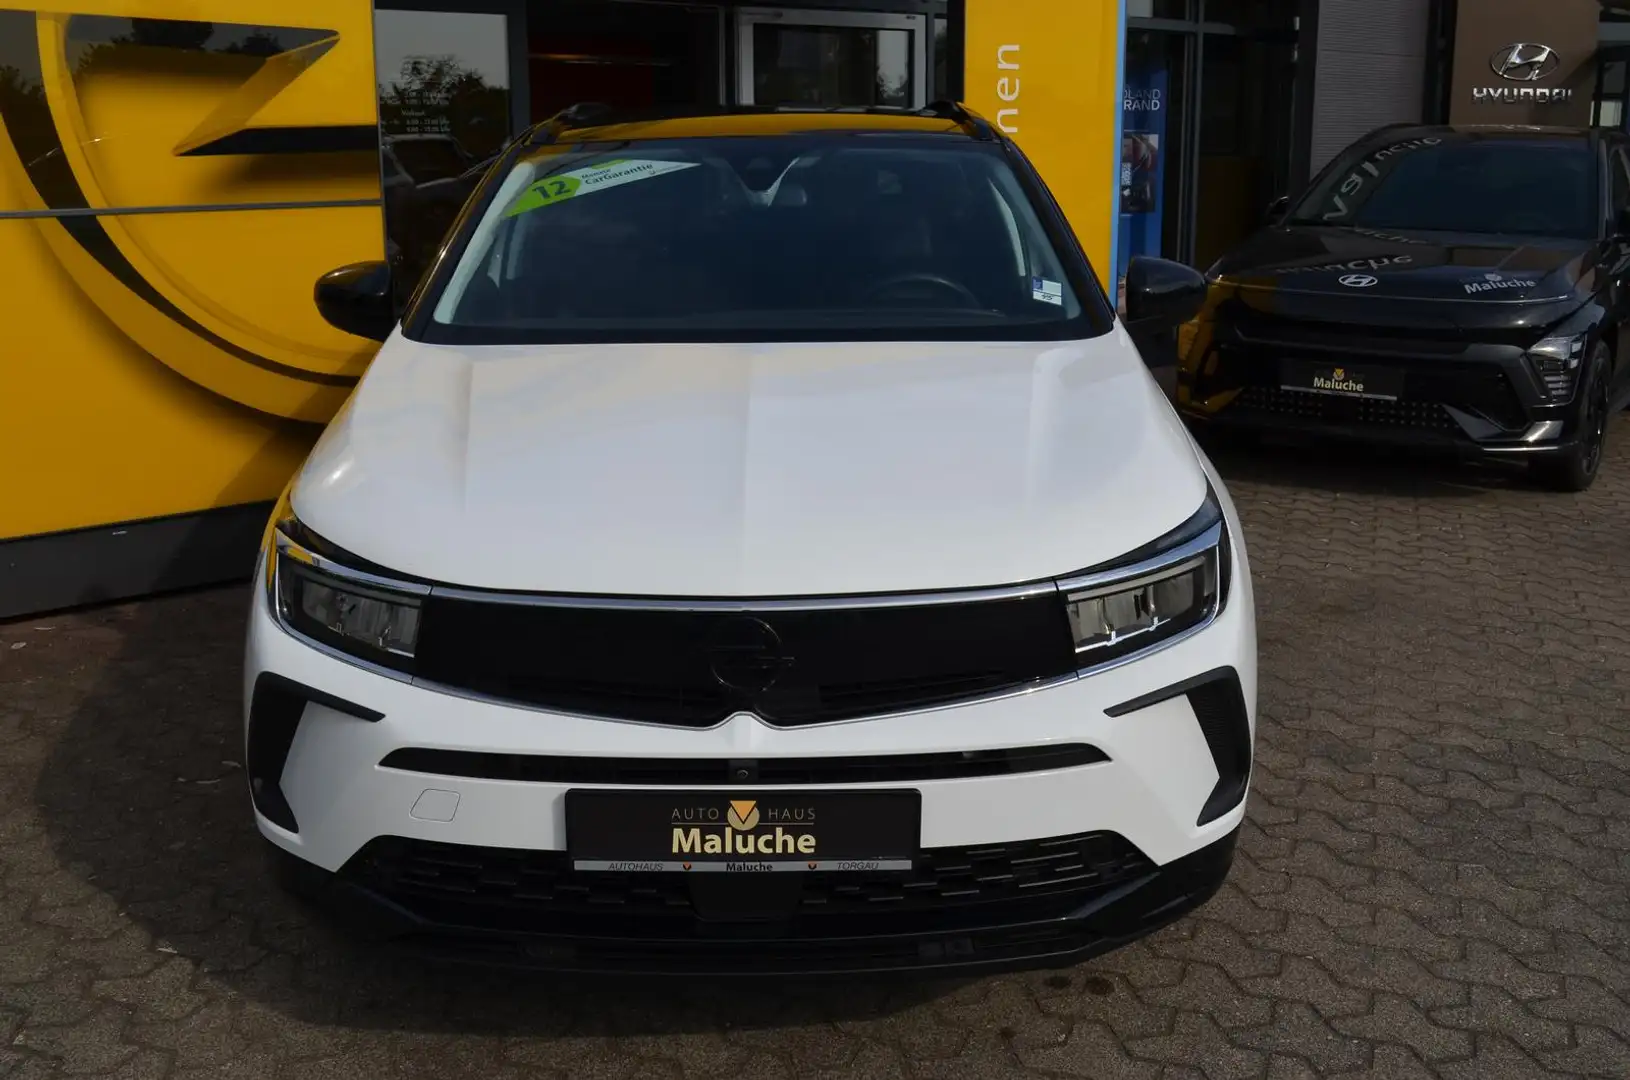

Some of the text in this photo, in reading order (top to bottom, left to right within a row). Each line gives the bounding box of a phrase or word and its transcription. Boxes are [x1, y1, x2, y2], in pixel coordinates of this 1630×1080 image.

[585, 163, 653, 185] CarGarantie
[532, 180, 571, 200] 12
[1463, 277, 1537, 294] Maluche
[1313, 376, 1364, 392] Maluche
[671, 808, 816, 820] AUTO HAUS
[672, 827, 816, 854] Maluche
[608, 861, 879, 872] AUTOHAUS Maluche TORGAU
